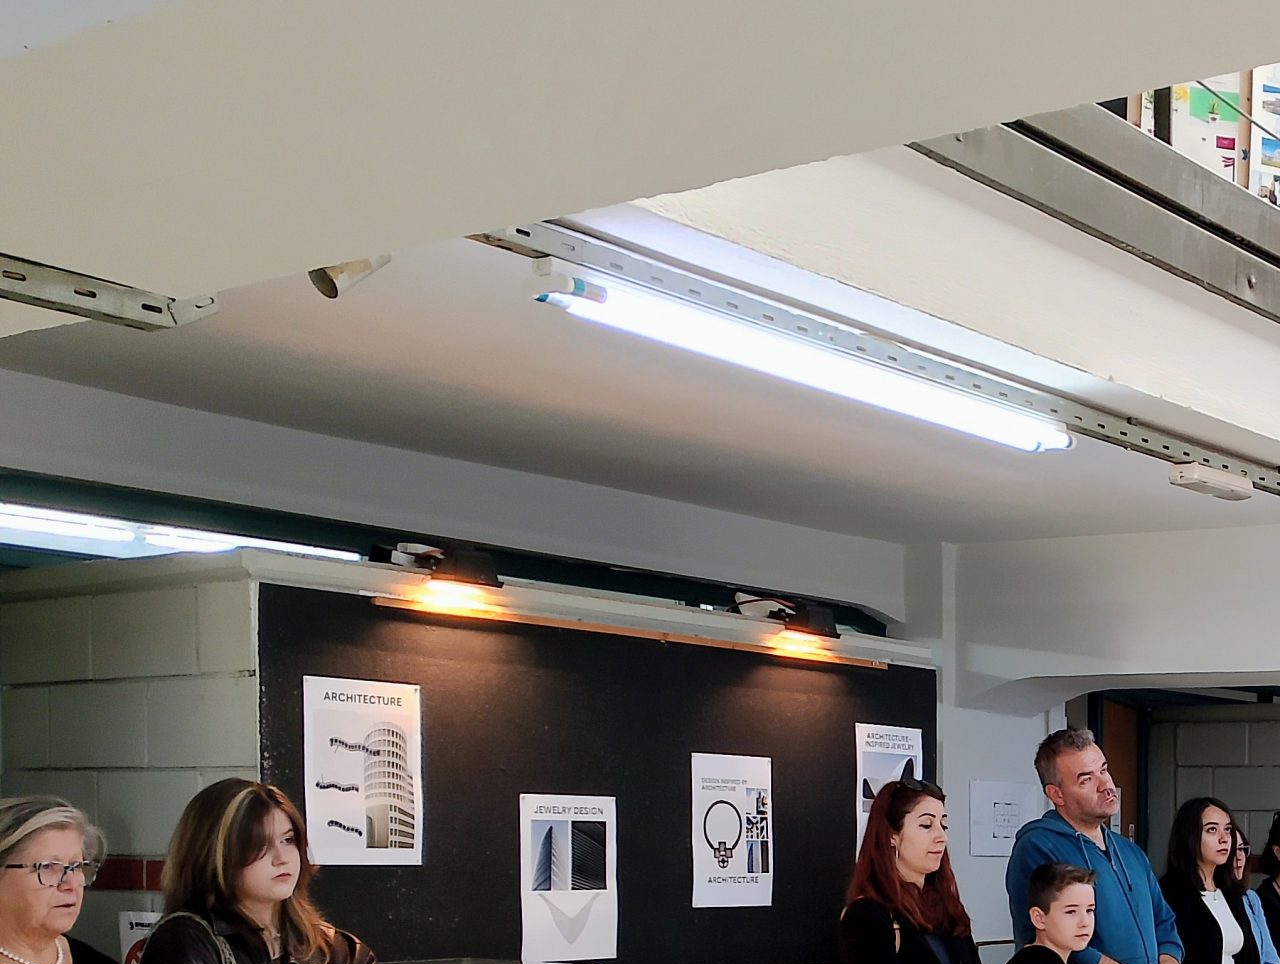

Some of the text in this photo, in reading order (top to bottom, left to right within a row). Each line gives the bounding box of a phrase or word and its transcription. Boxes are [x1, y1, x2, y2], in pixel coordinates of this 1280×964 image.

[323, 691, 403, 707] ARCHITECTURE
[534, 805, 604, 816] JEWELRY DESIGN
[708, 876, 760, 884] ARCHITECTURE
